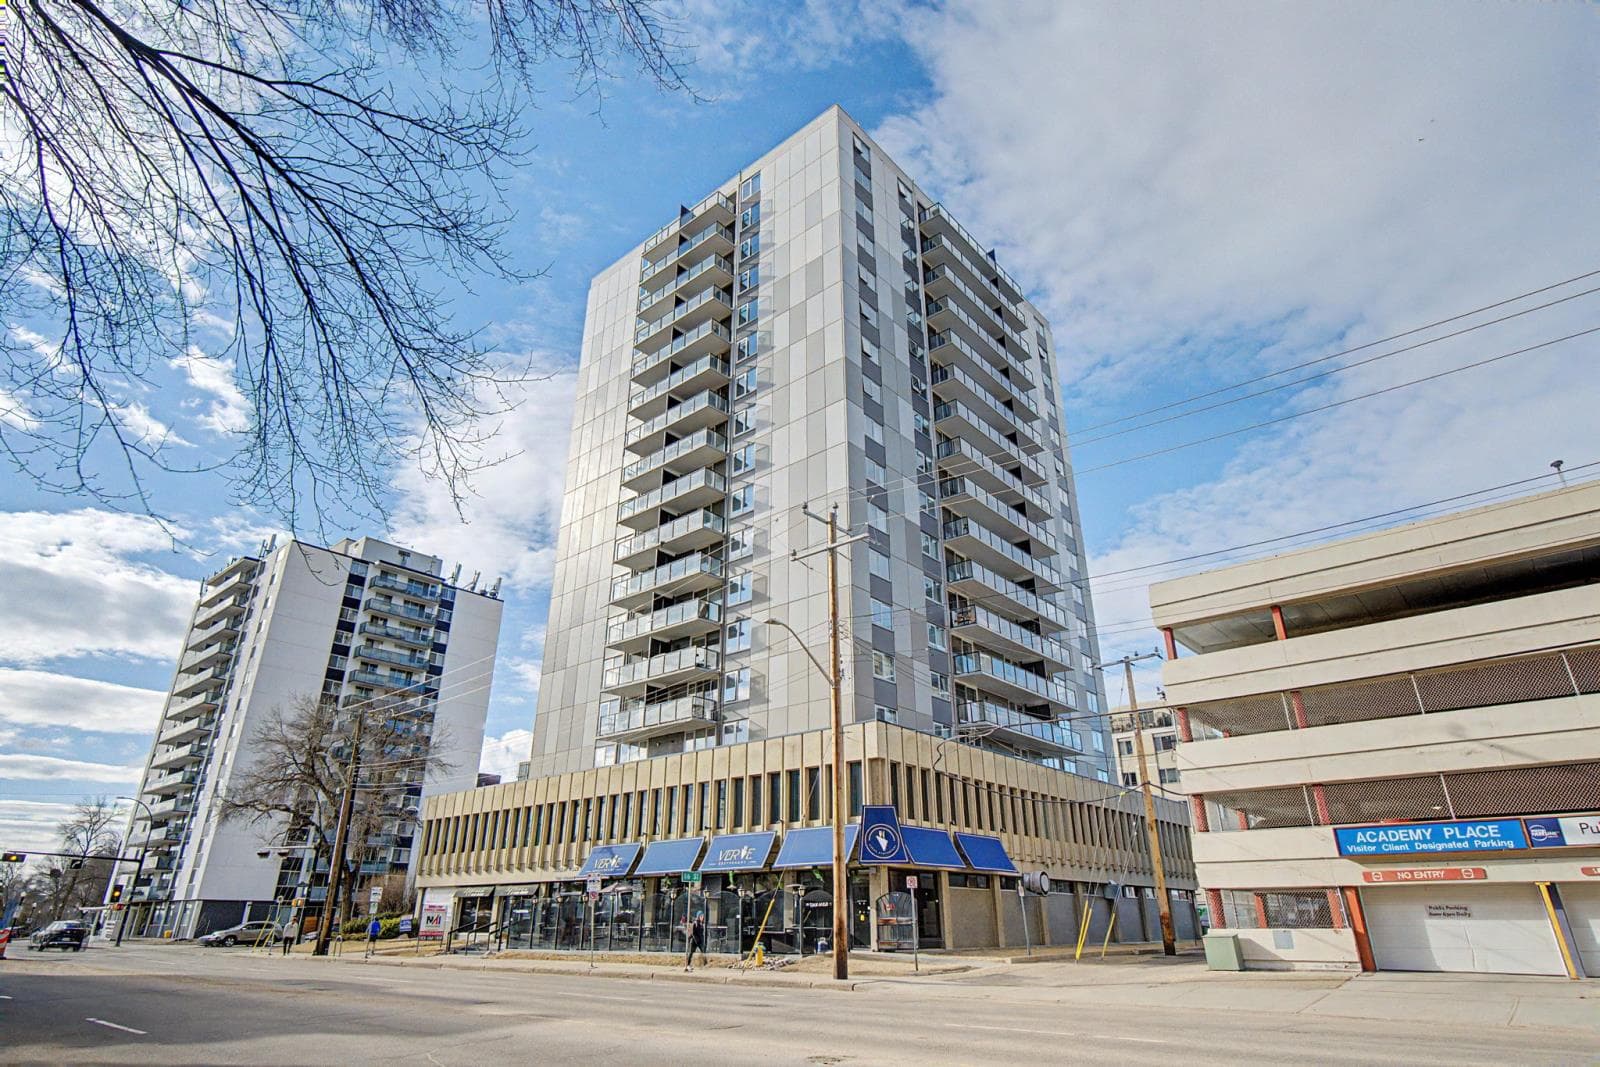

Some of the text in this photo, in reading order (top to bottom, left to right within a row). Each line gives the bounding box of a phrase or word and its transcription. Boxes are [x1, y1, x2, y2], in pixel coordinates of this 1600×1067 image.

[1356, 825, 1501, 843] ACADEMY PLACE
[1347, 840, 1514, 853] Visitor Client Designated Parking
[1396, 870, 1445, 880] NO ENTRY
